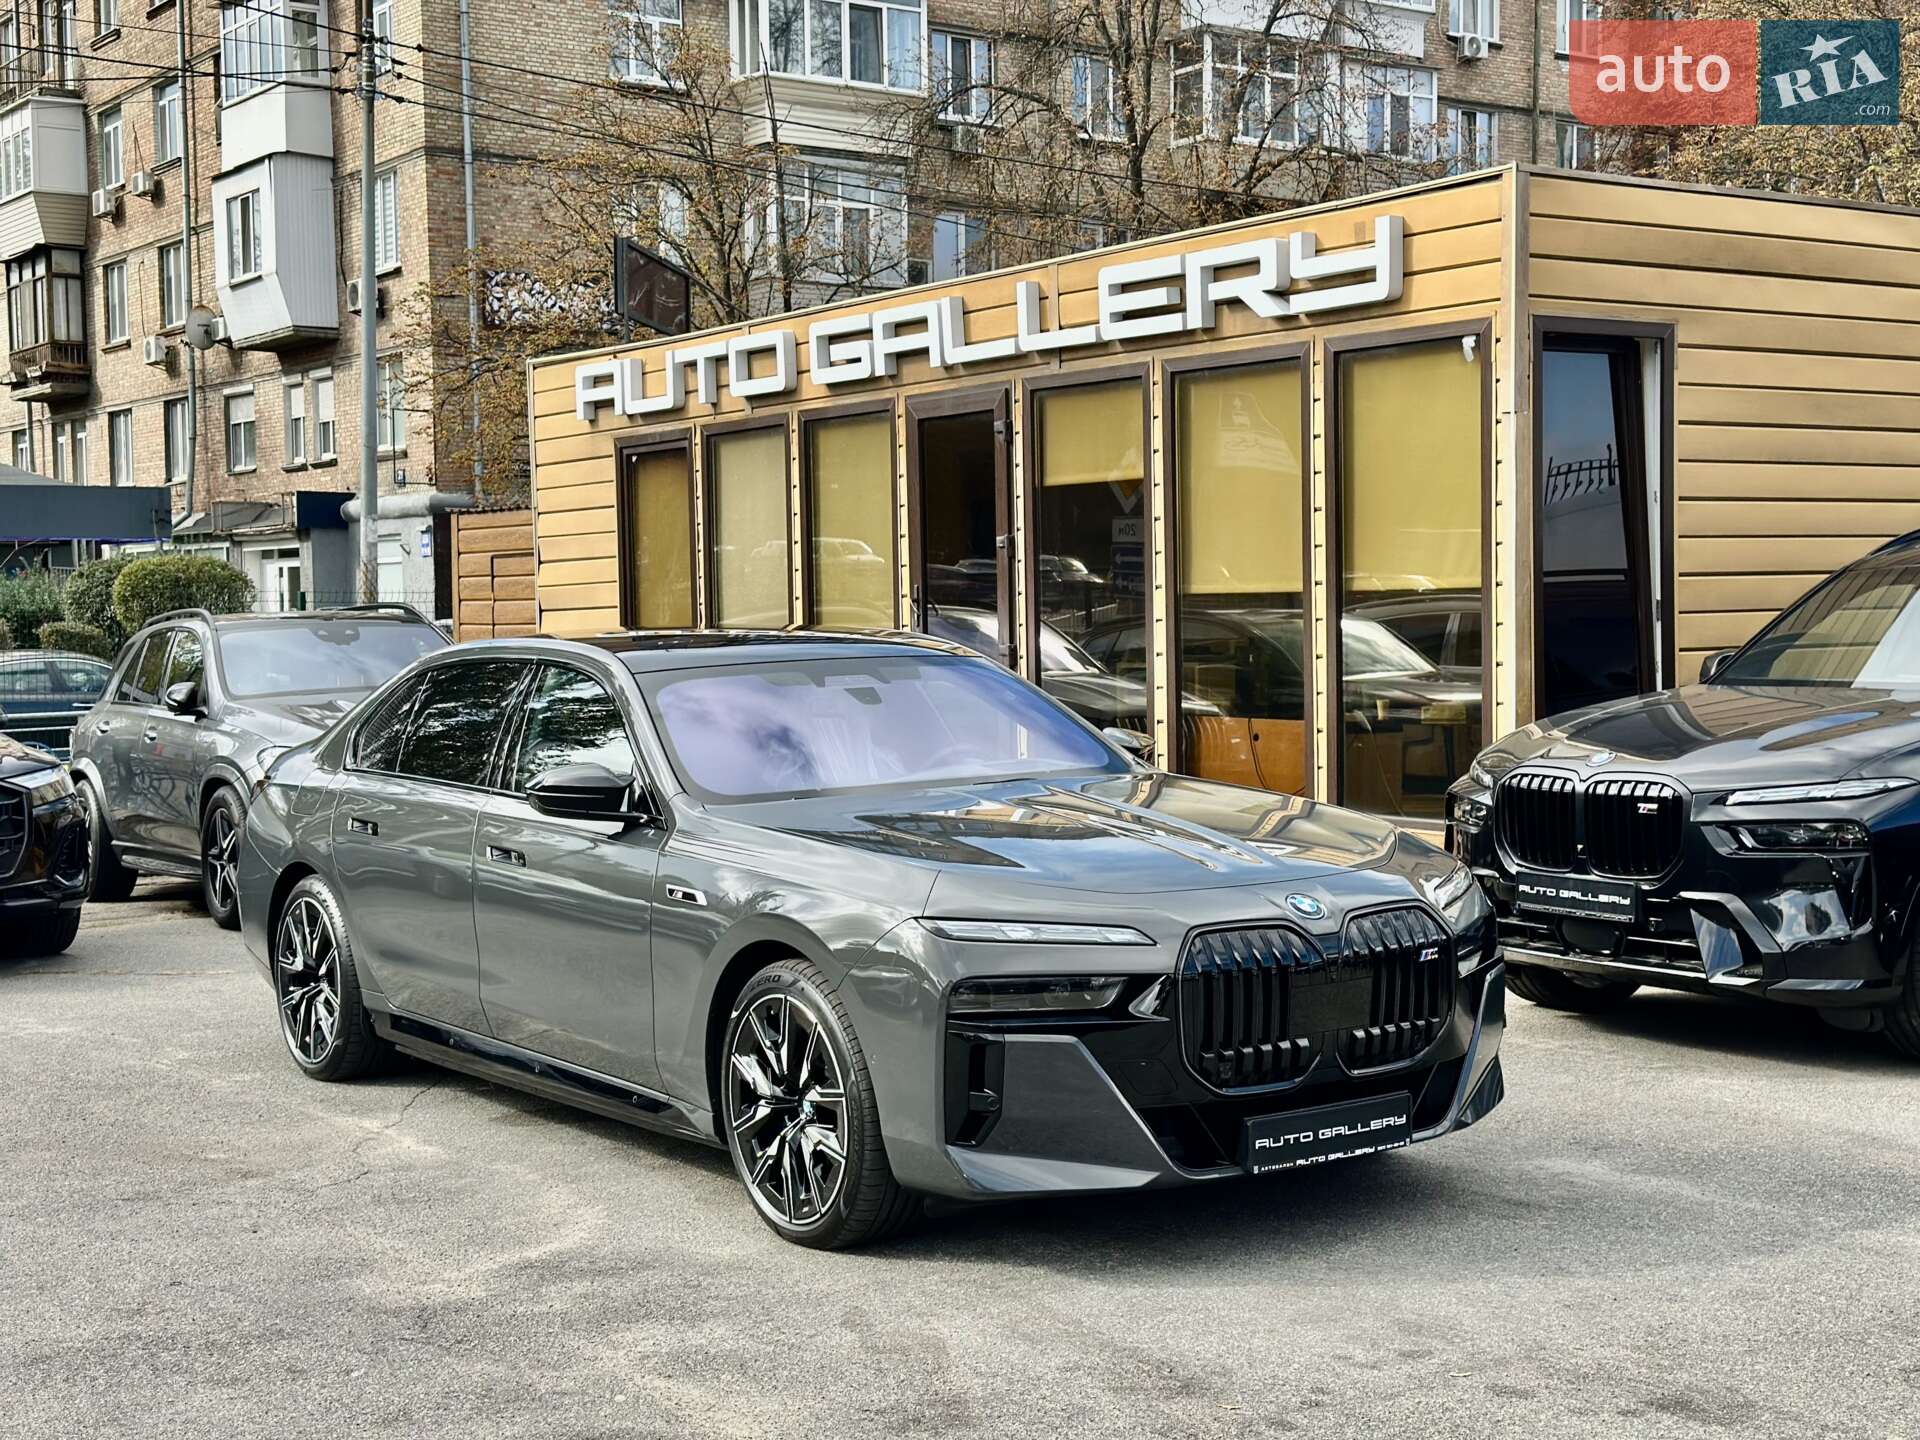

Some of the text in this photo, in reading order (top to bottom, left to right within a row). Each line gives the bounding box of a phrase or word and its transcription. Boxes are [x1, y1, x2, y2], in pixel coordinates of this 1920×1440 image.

[576, 215, 1404, 421] AUTO GALLERY
[1518, 884, 1631, 905] AUTO GALLERY
[1255, 1114, 1407, 1150] AUTO GALLERY
[1296, 1155, 1326, 1166] AUTO
[1328, 1146, 1376, 1161] GALLERY
